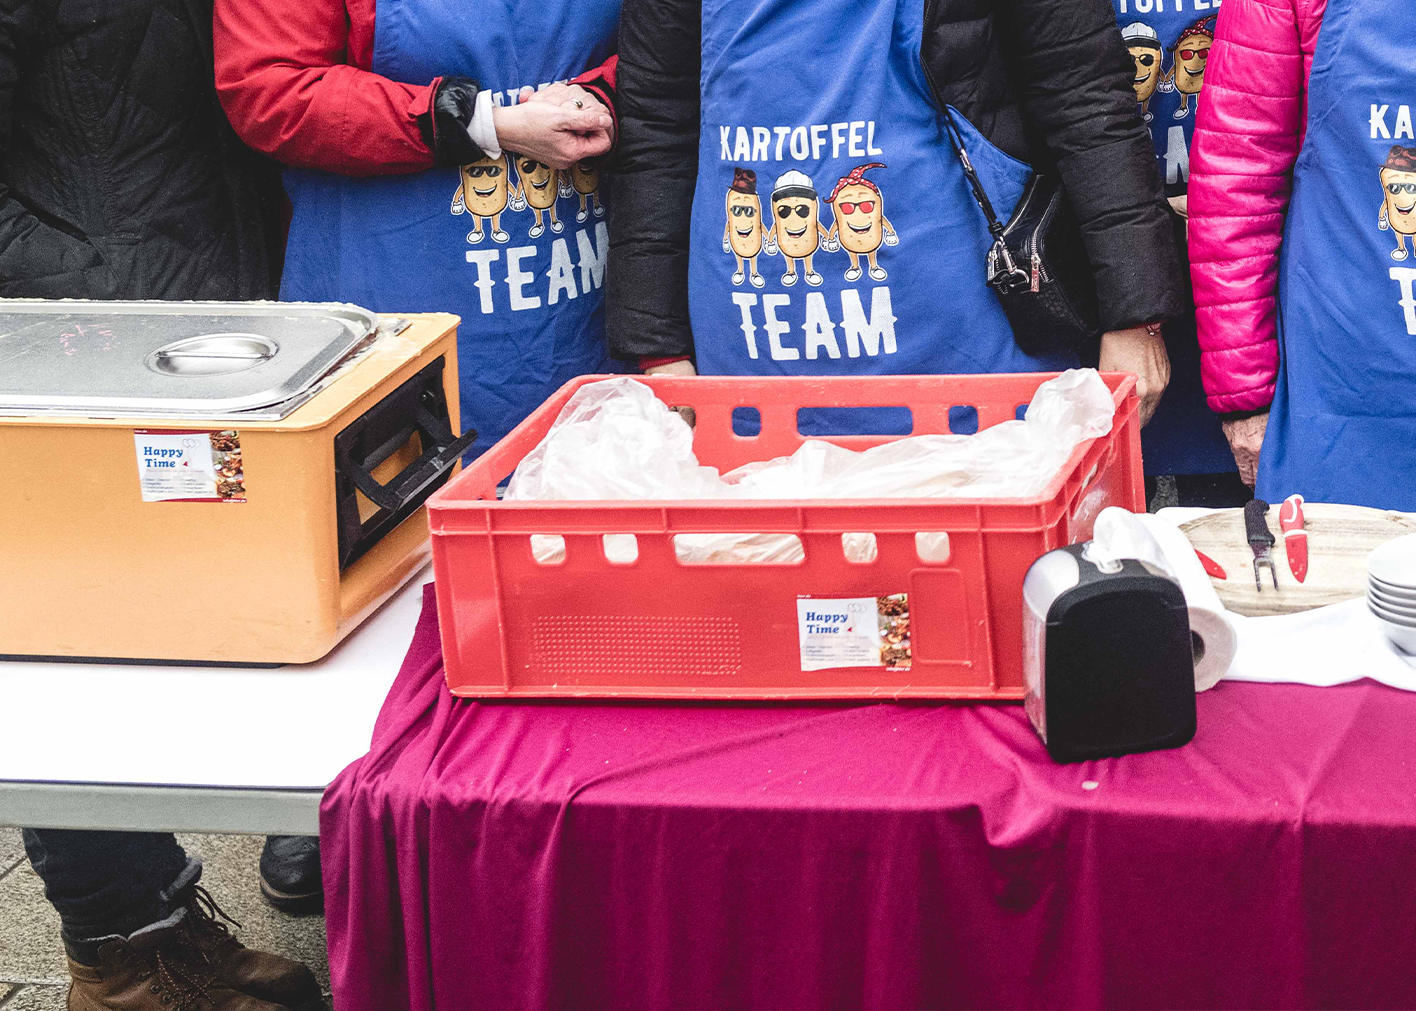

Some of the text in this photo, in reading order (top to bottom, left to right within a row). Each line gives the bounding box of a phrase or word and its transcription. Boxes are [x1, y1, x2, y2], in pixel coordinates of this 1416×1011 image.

[719, 120, 883, 162] KARTOFFEL
[465, 220, 611, 315] TEAM
[731, 285, 899, 362] TEAM
[143, 446, 184, 458] Happy
[144, 458, 176, 468] Time
[806, 611, 849, 624] Happy
[806, 624, 840, 635] Time
